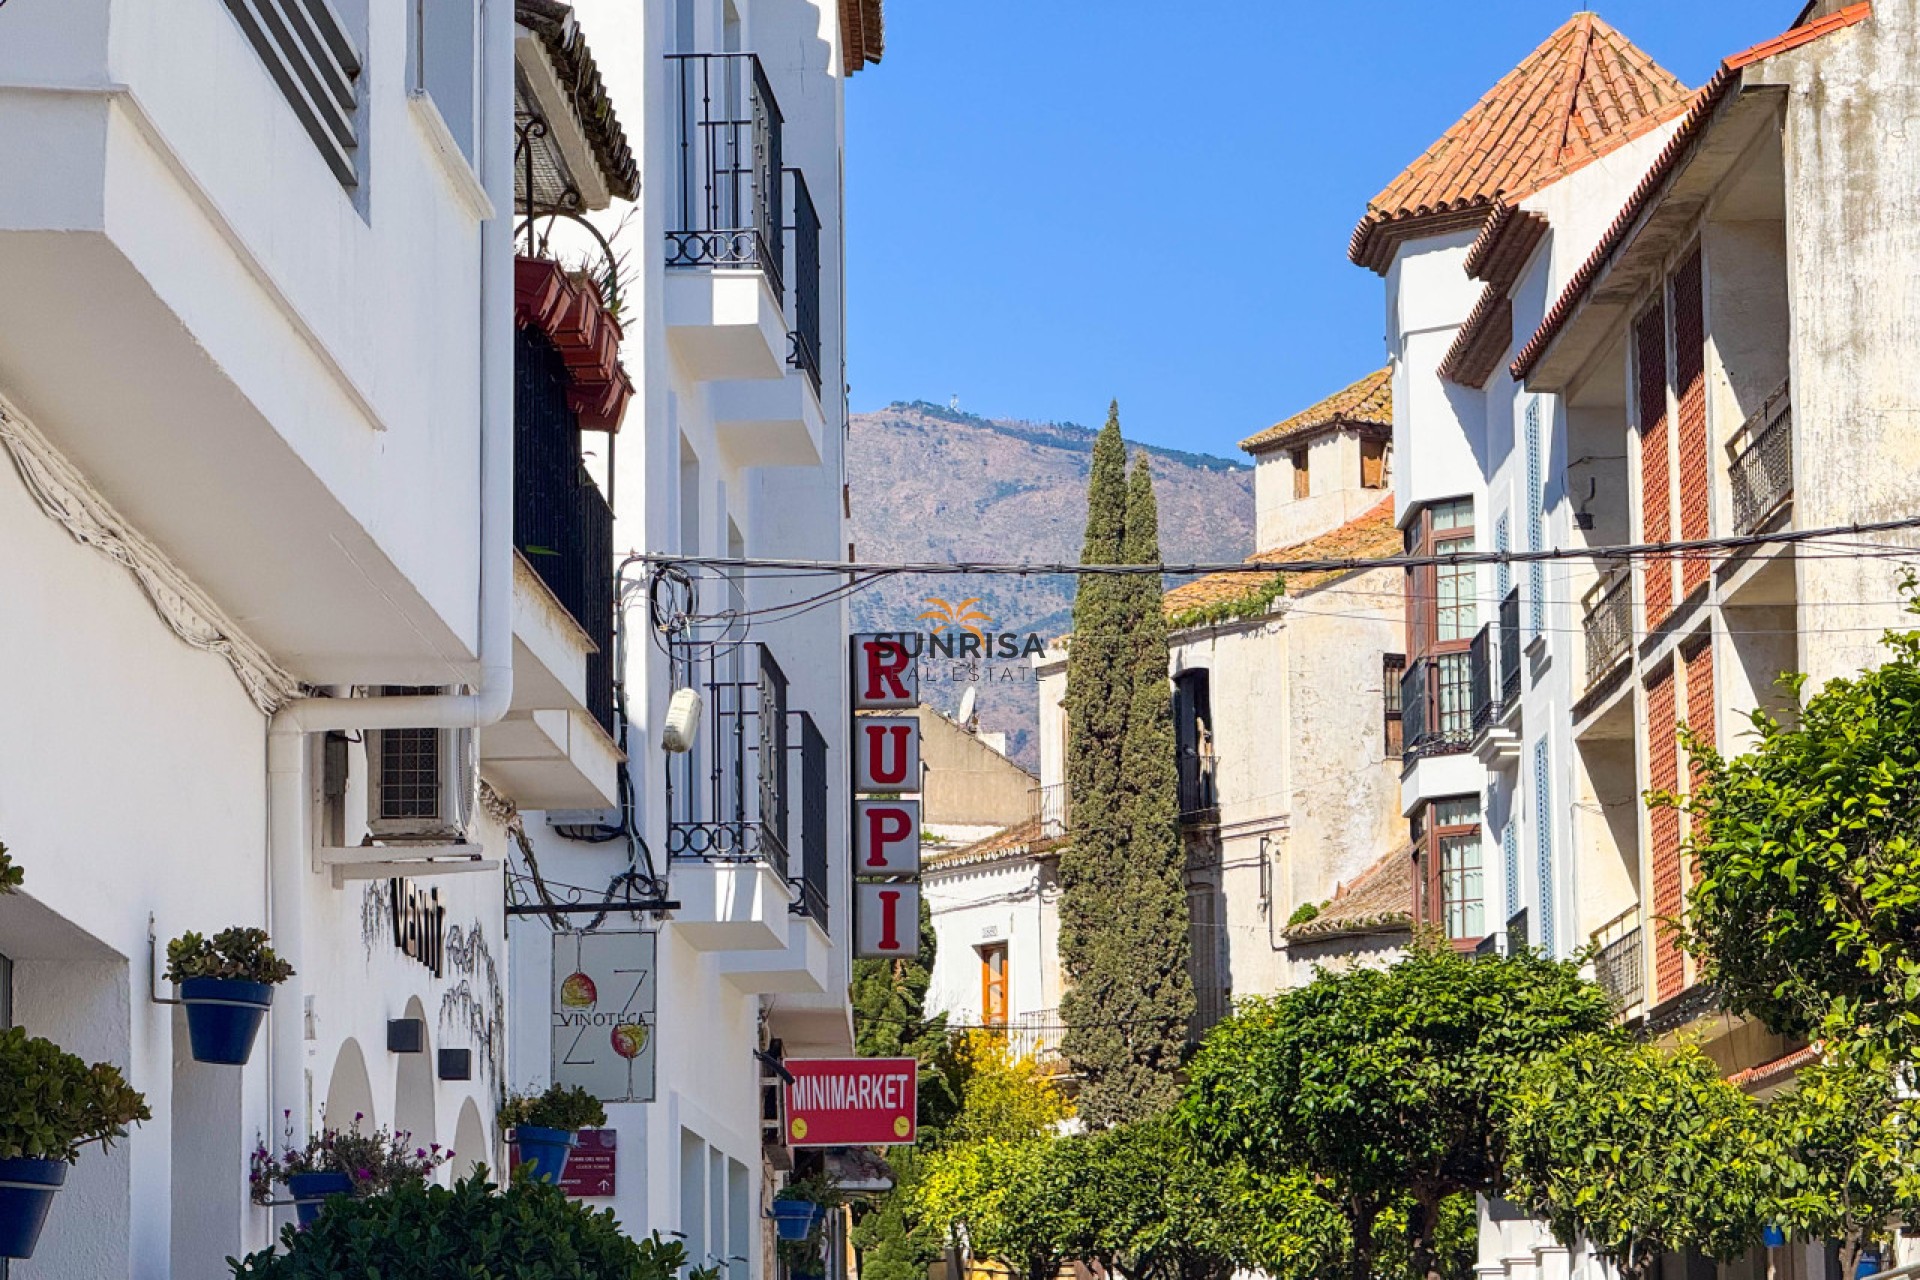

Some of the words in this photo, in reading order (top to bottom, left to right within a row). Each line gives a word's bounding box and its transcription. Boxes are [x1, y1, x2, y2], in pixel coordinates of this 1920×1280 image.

[863, 641, 912, 951] RUPI
[561, 1012, 646, 1027] VINOTECA
[791, 1074, 909, 1111] MINIMARKET
